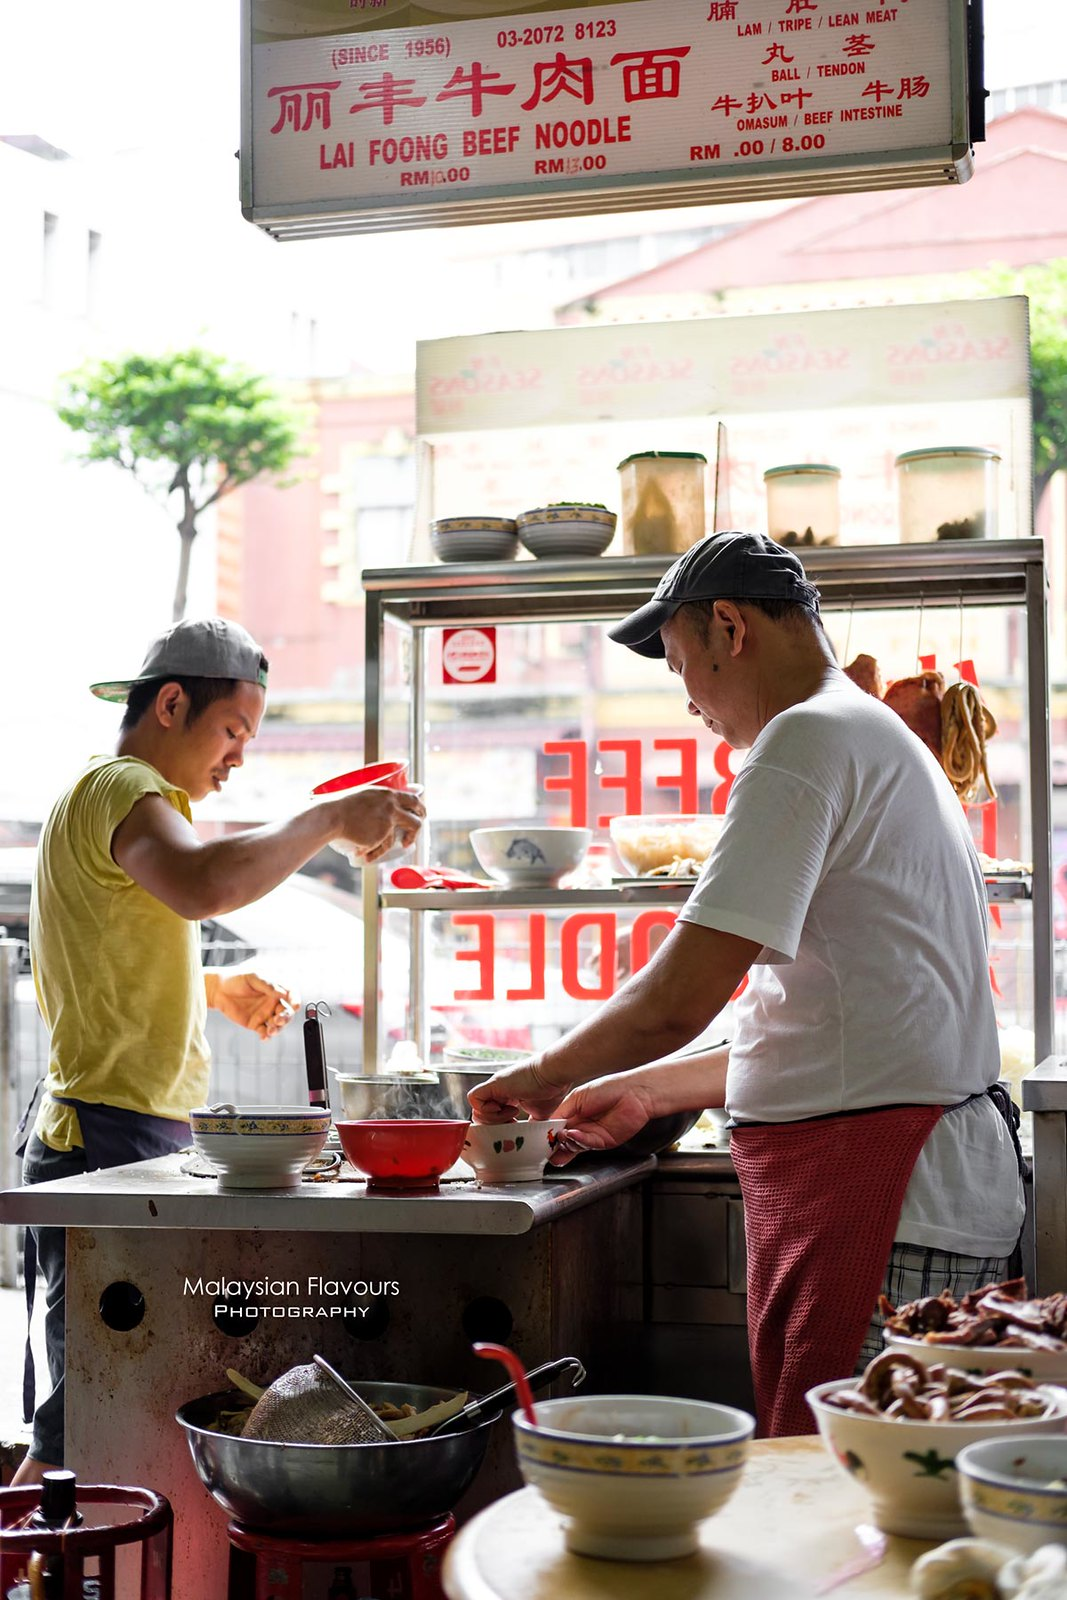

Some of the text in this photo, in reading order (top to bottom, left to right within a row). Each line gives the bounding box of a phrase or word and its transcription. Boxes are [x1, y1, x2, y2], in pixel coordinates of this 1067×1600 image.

[497, 19, 616, 48] 03-2072 8123
[737, 23, 762, 37] LAM
[778, 18, 812, 32] TRIPE
[828, 13, 859, 27] LEAN
[866, 9, 898, 24] MEAT
[332, 37, 451, 70] (SINCE 1956)
[761, 42, 795, 65] 丸
[772, 65, 800, 82] BALL
[817, 62, 865, 77] TENDON
[267, 46, 691, 135] 丽丰牛肉面
[711, 75, 930, 117] 牛扒叶 牛肠
[737, 115, 787, 131] OMASUM
[804, 111, 833, 125] BEEF
[841, 104, 903, 122] INTESTINE
[320, 115, 631, 170] LAI FOONG BEEF NOODLE
[690, 144, 720, 160] RM
[782, 134, 825, 152] 8.00
